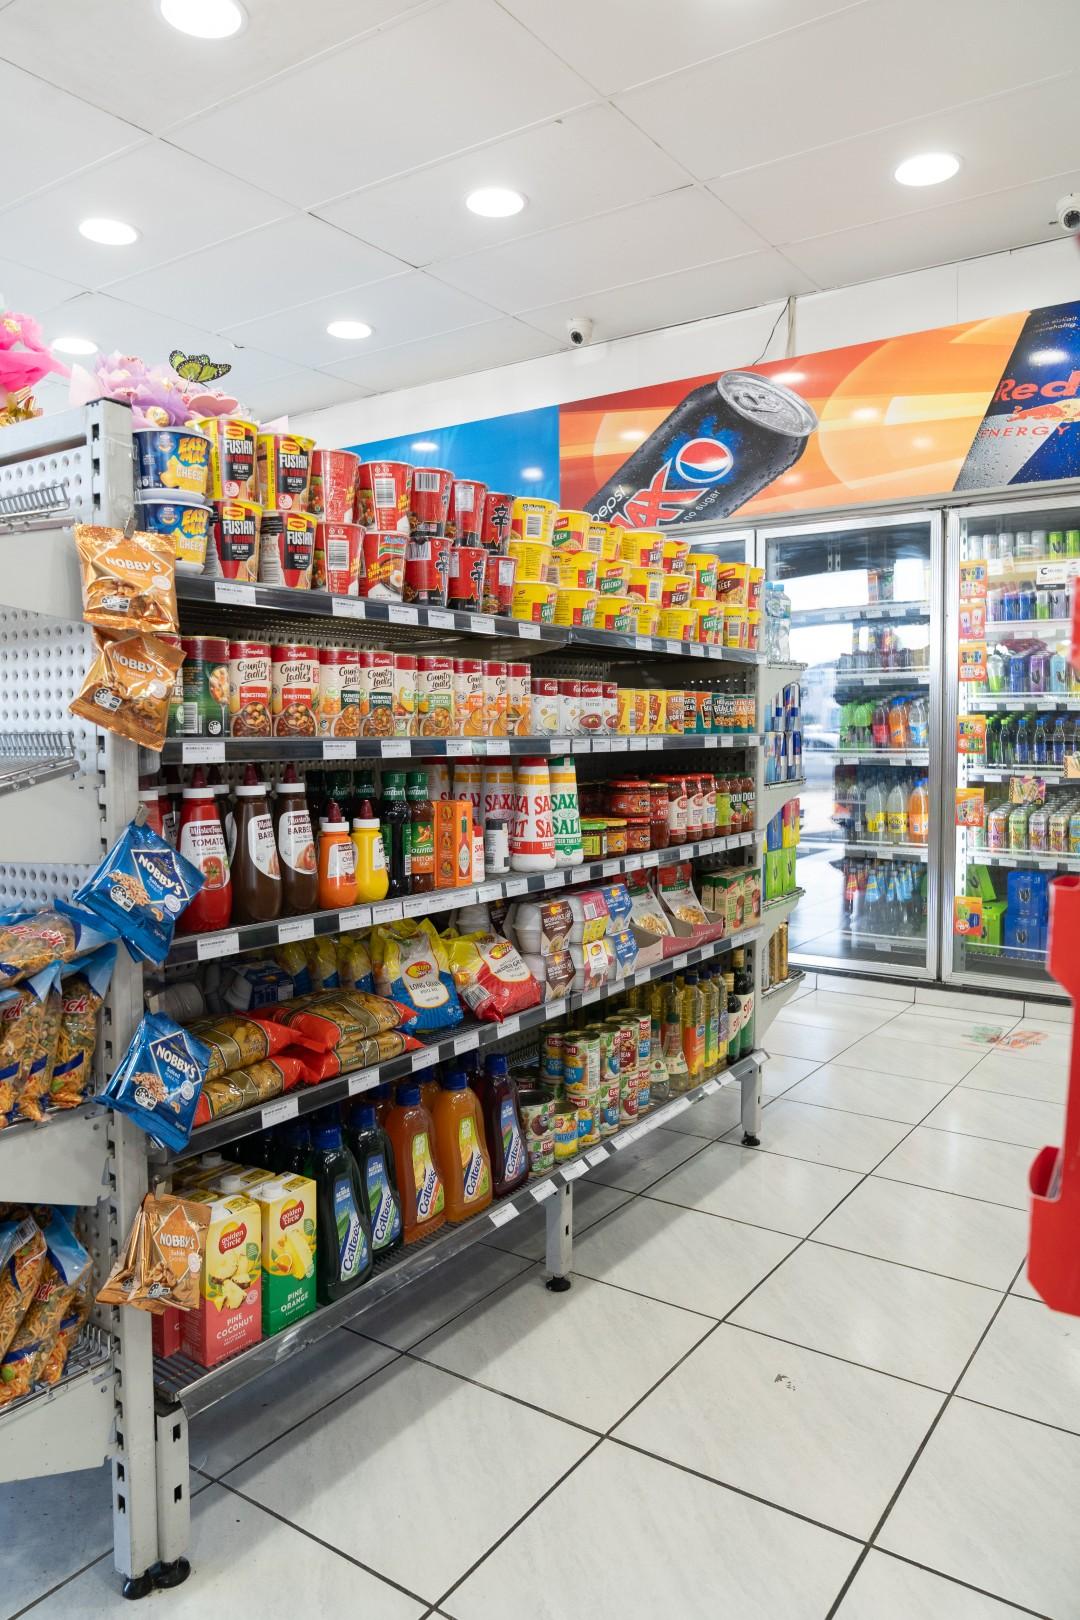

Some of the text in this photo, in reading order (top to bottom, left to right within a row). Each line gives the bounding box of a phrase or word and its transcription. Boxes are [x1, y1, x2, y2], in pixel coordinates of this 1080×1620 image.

[994, 370, 1080, 402] Red
[978, 424, 1072, 439] ENERGY
[224, 440, 253, 455] FUSIAN
[279, 454, 308, 469] FUSIAN
[590, 484, 627, 522] pepsi
[684, 489, 722, 522] no sugar
[223, 520, 255, 535] FUSIAN
[286, 531, 313, 545] FUSIAN
[104, 554, 163, 575] NOBBY'S
[112, 651, 165, 678] NOBBY'S
[237, 660, 267, 673] Country
[280, 663, 311, 676] Country
[138, 854, 182, 896] NOBBY'S
[409, 982, 425, 991] LONG
[156, 1044, 197, 1079] NOBBY'S
[167, 1066, 180, 1079] Salted
[466, 1152, 483, 1196] Cottee's
[419, 1170, 436, 1214] Cottee's
[282, 1207, 302, 1221] golden
[284, 1214, 300, 1225] circle
[375, 1192, 393, 1242] Cottee's
[159, 1232, 196, 1250] NOBBY'S
[221, 1230, 244, 1244] golden
[223, 1237, 242, 1249] circle
[343, 1221, 362, 1272] Cottee's
[287, 1287, 303, 1301] PINE
[280, 1292, 309, 1313] ORANGE
[216, 1314, 254, 1340] COCONUT
[227, 1313, 243, 1326] PINE
